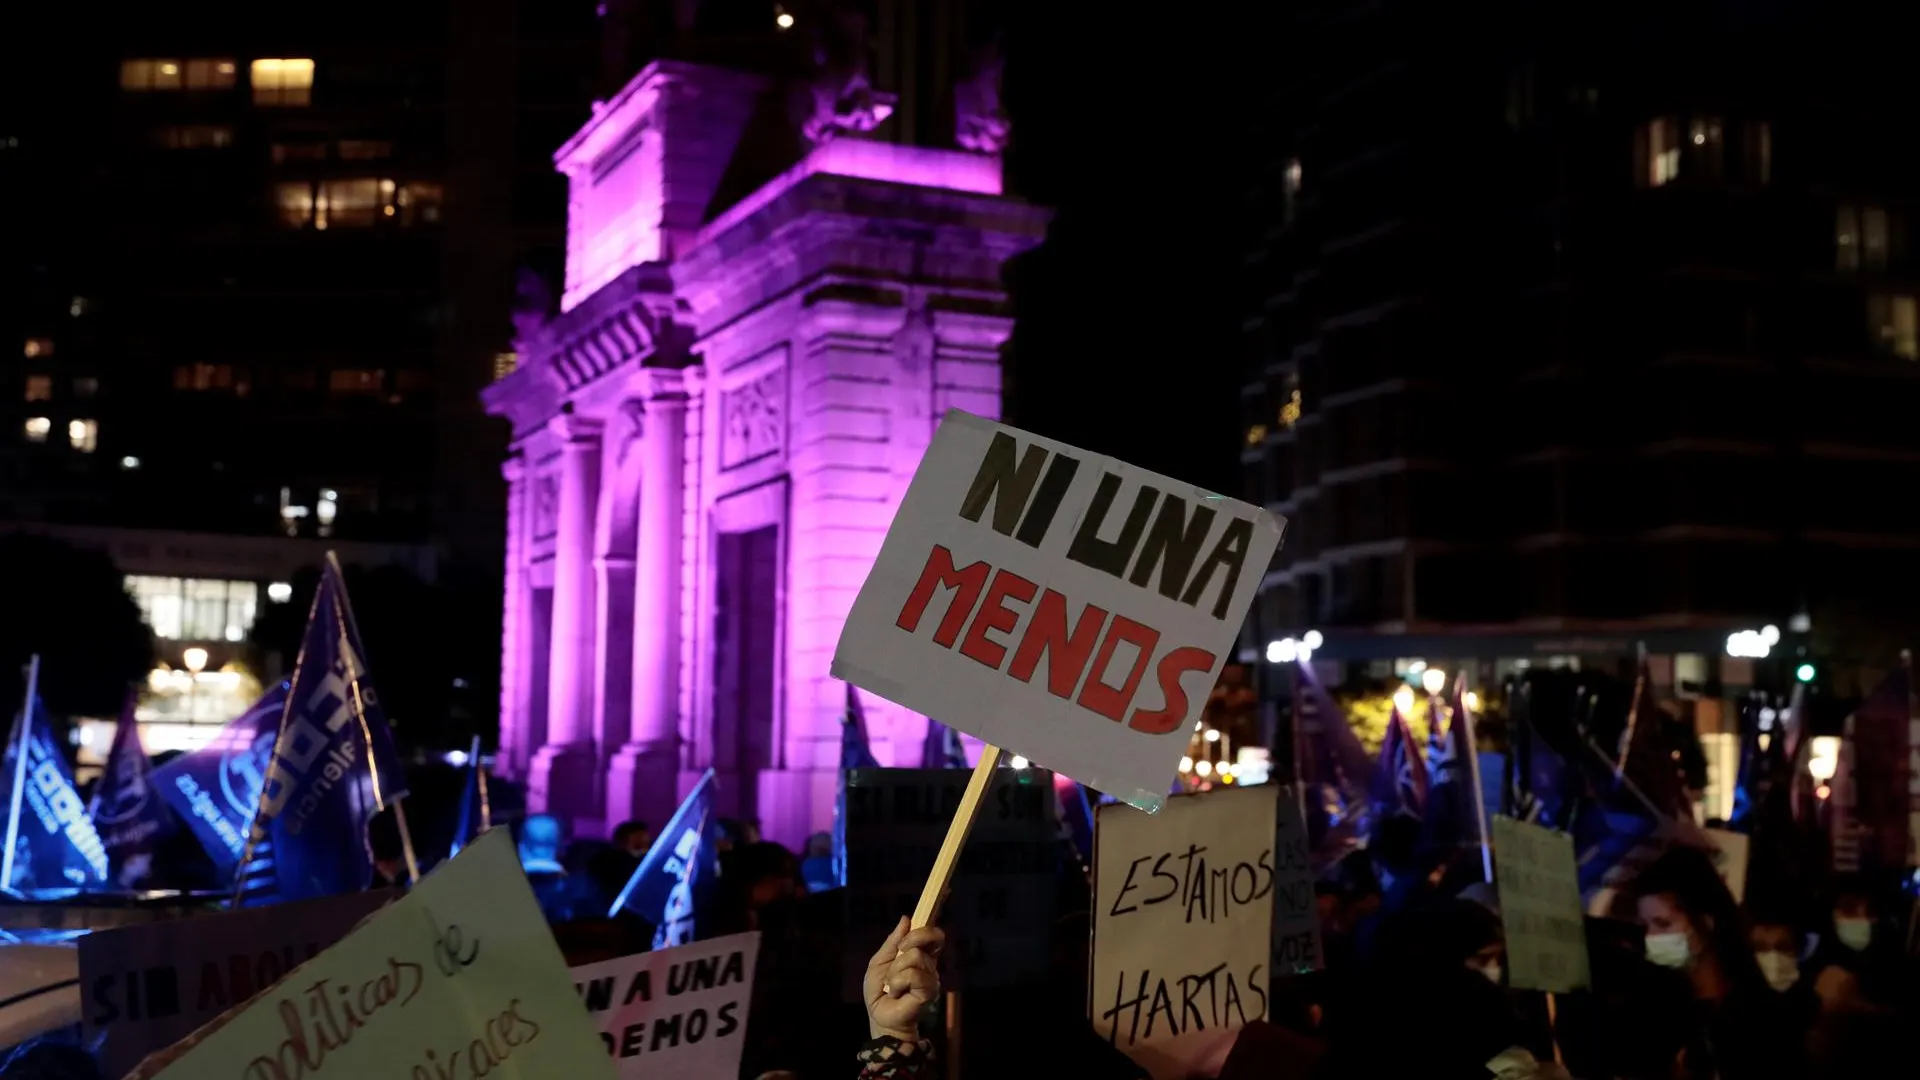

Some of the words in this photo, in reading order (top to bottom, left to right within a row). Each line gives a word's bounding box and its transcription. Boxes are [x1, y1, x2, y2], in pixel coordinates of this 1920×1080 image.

[958, 431, 1080, 549] NI
[1066, 471, 1254, 620] UNA
[895, 543, 1217, 735] MENOS
[1110, 843, 1276, 924] ESTAMOS
[1279, 879, 1309, 911] NO
[422, 906, 480, 977] de
[623, 970, 652, 1006] A
[667, 951, 743, 996] UNA
[93, 965, 181, 1026] SIN
[1103, 962, 1268, 1046] HARTAS
